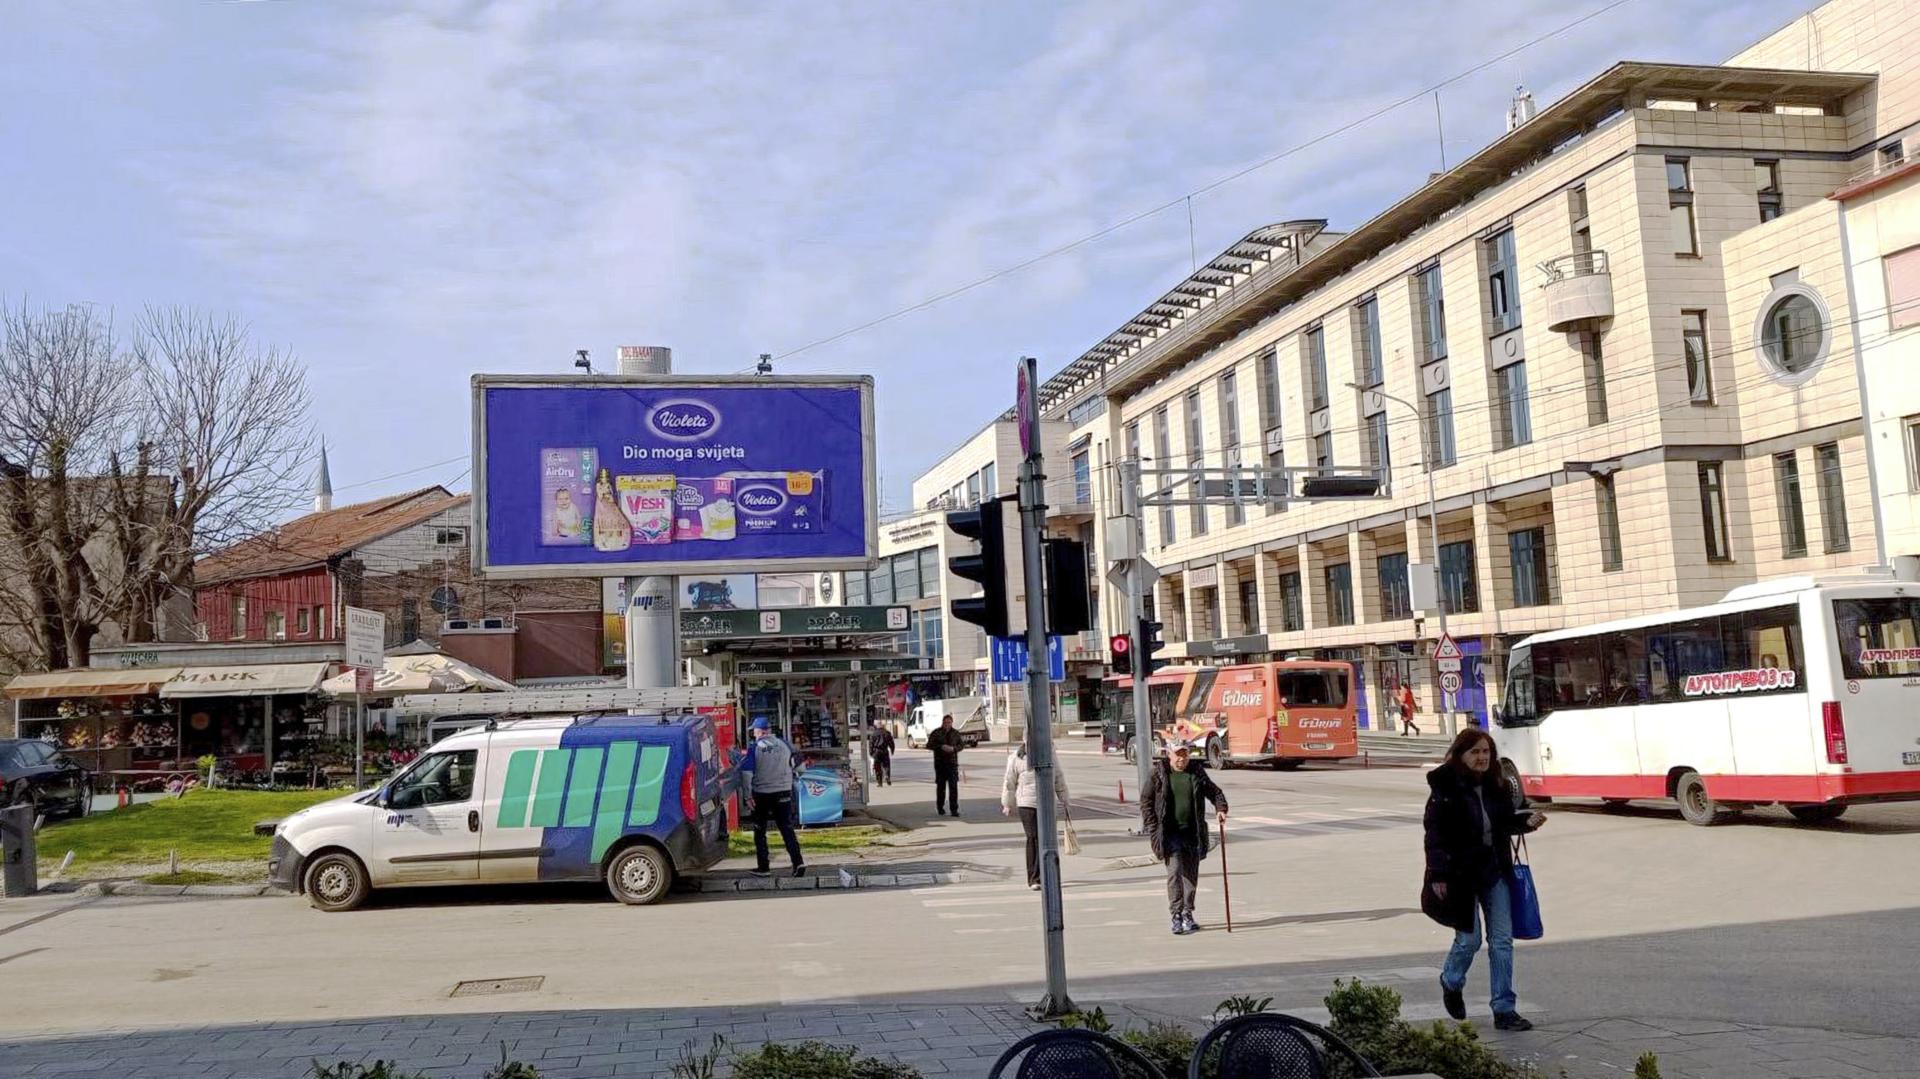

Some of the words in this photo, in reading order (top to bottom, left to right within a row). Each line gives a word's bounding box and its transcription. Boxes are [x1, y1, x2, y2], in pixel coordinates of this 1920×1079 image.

[659, 410, 708, 427] Violeta
[623, 445, 647, 459] Dio
[652, 447, 693, 461] moga
[697, 445, 745, 461] svijeta
[743, 494, 777, 506] Violeta
[1444, 676, 1457, 689] 30
